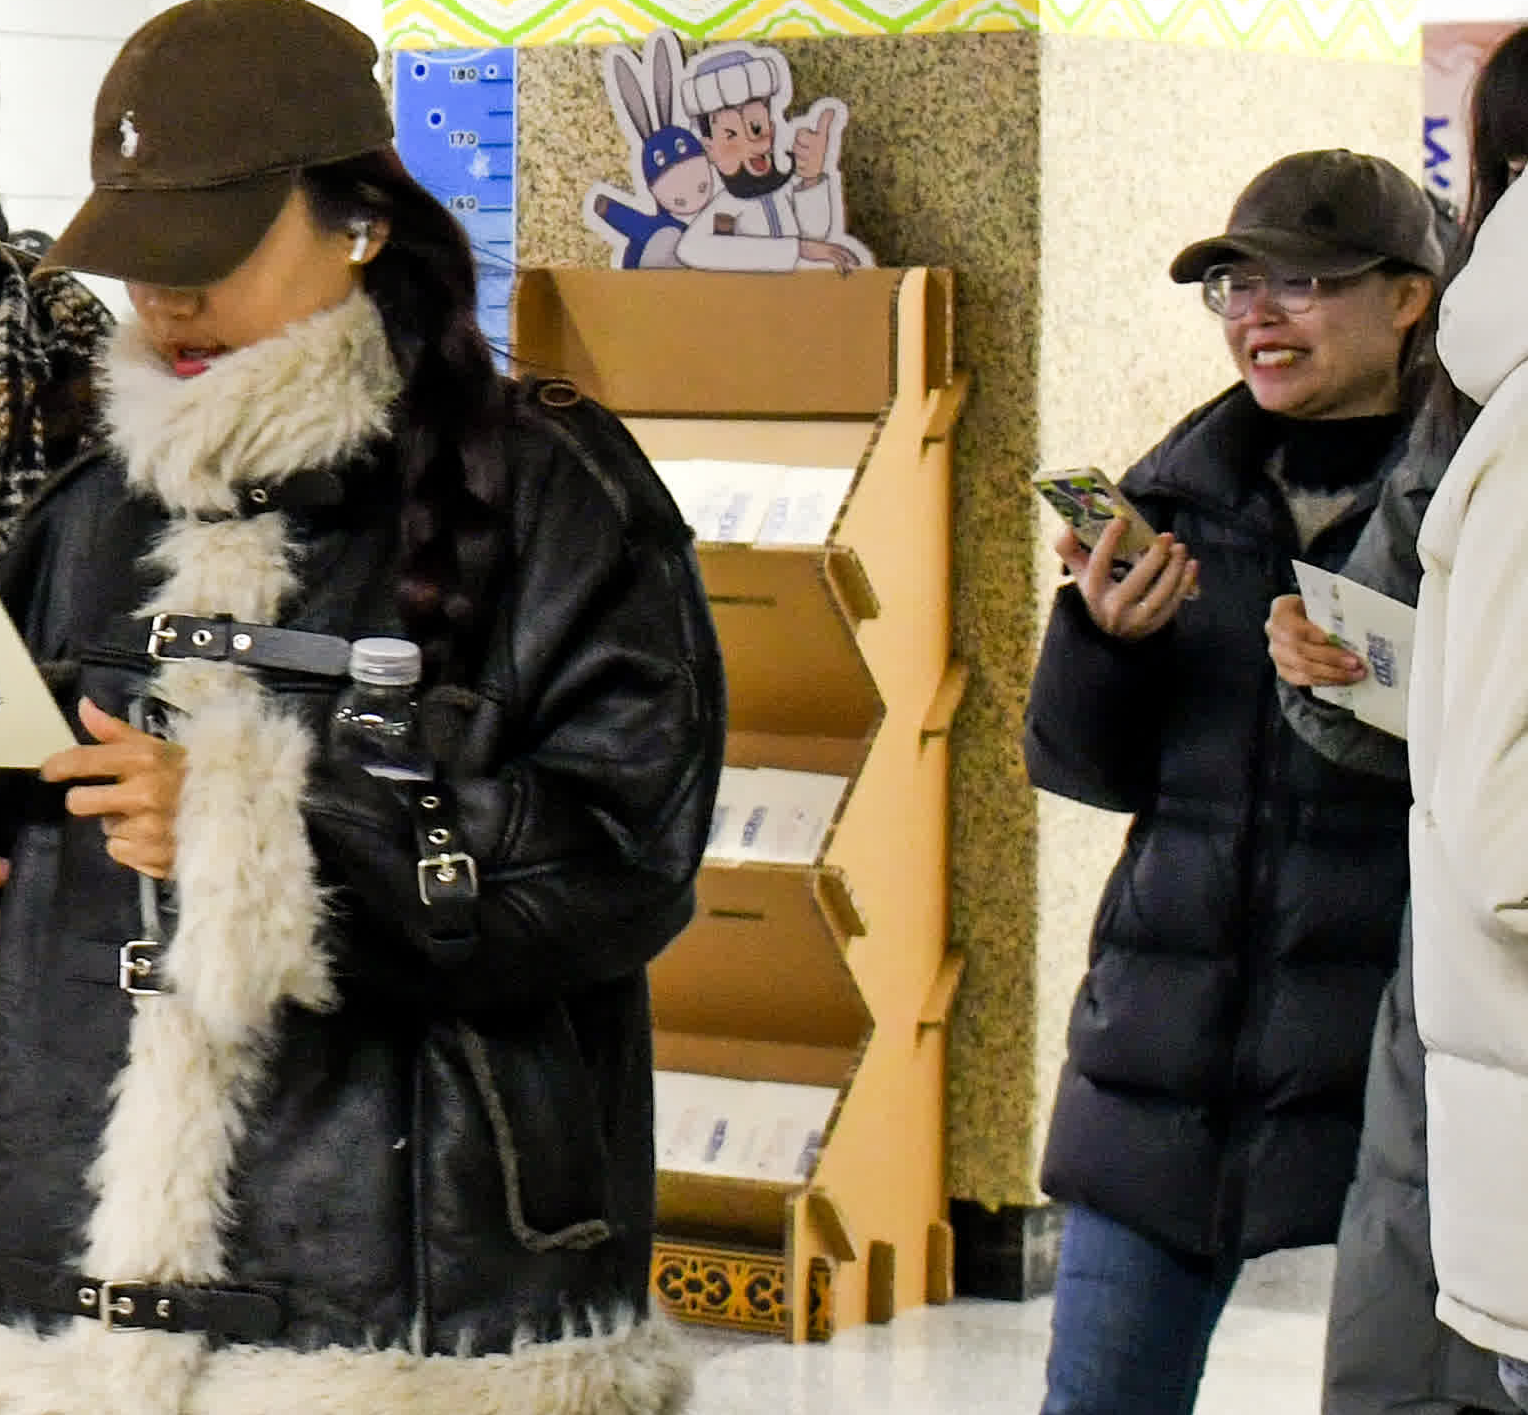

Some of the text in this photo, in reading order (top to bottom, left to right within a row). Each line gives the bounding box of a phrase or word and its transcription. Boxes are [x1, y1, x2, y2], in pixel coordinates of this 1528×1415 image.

[451, 68, 477, 80] 180
[450, 133, 476, 145] 170
[449, 197, 476, 210] 160
